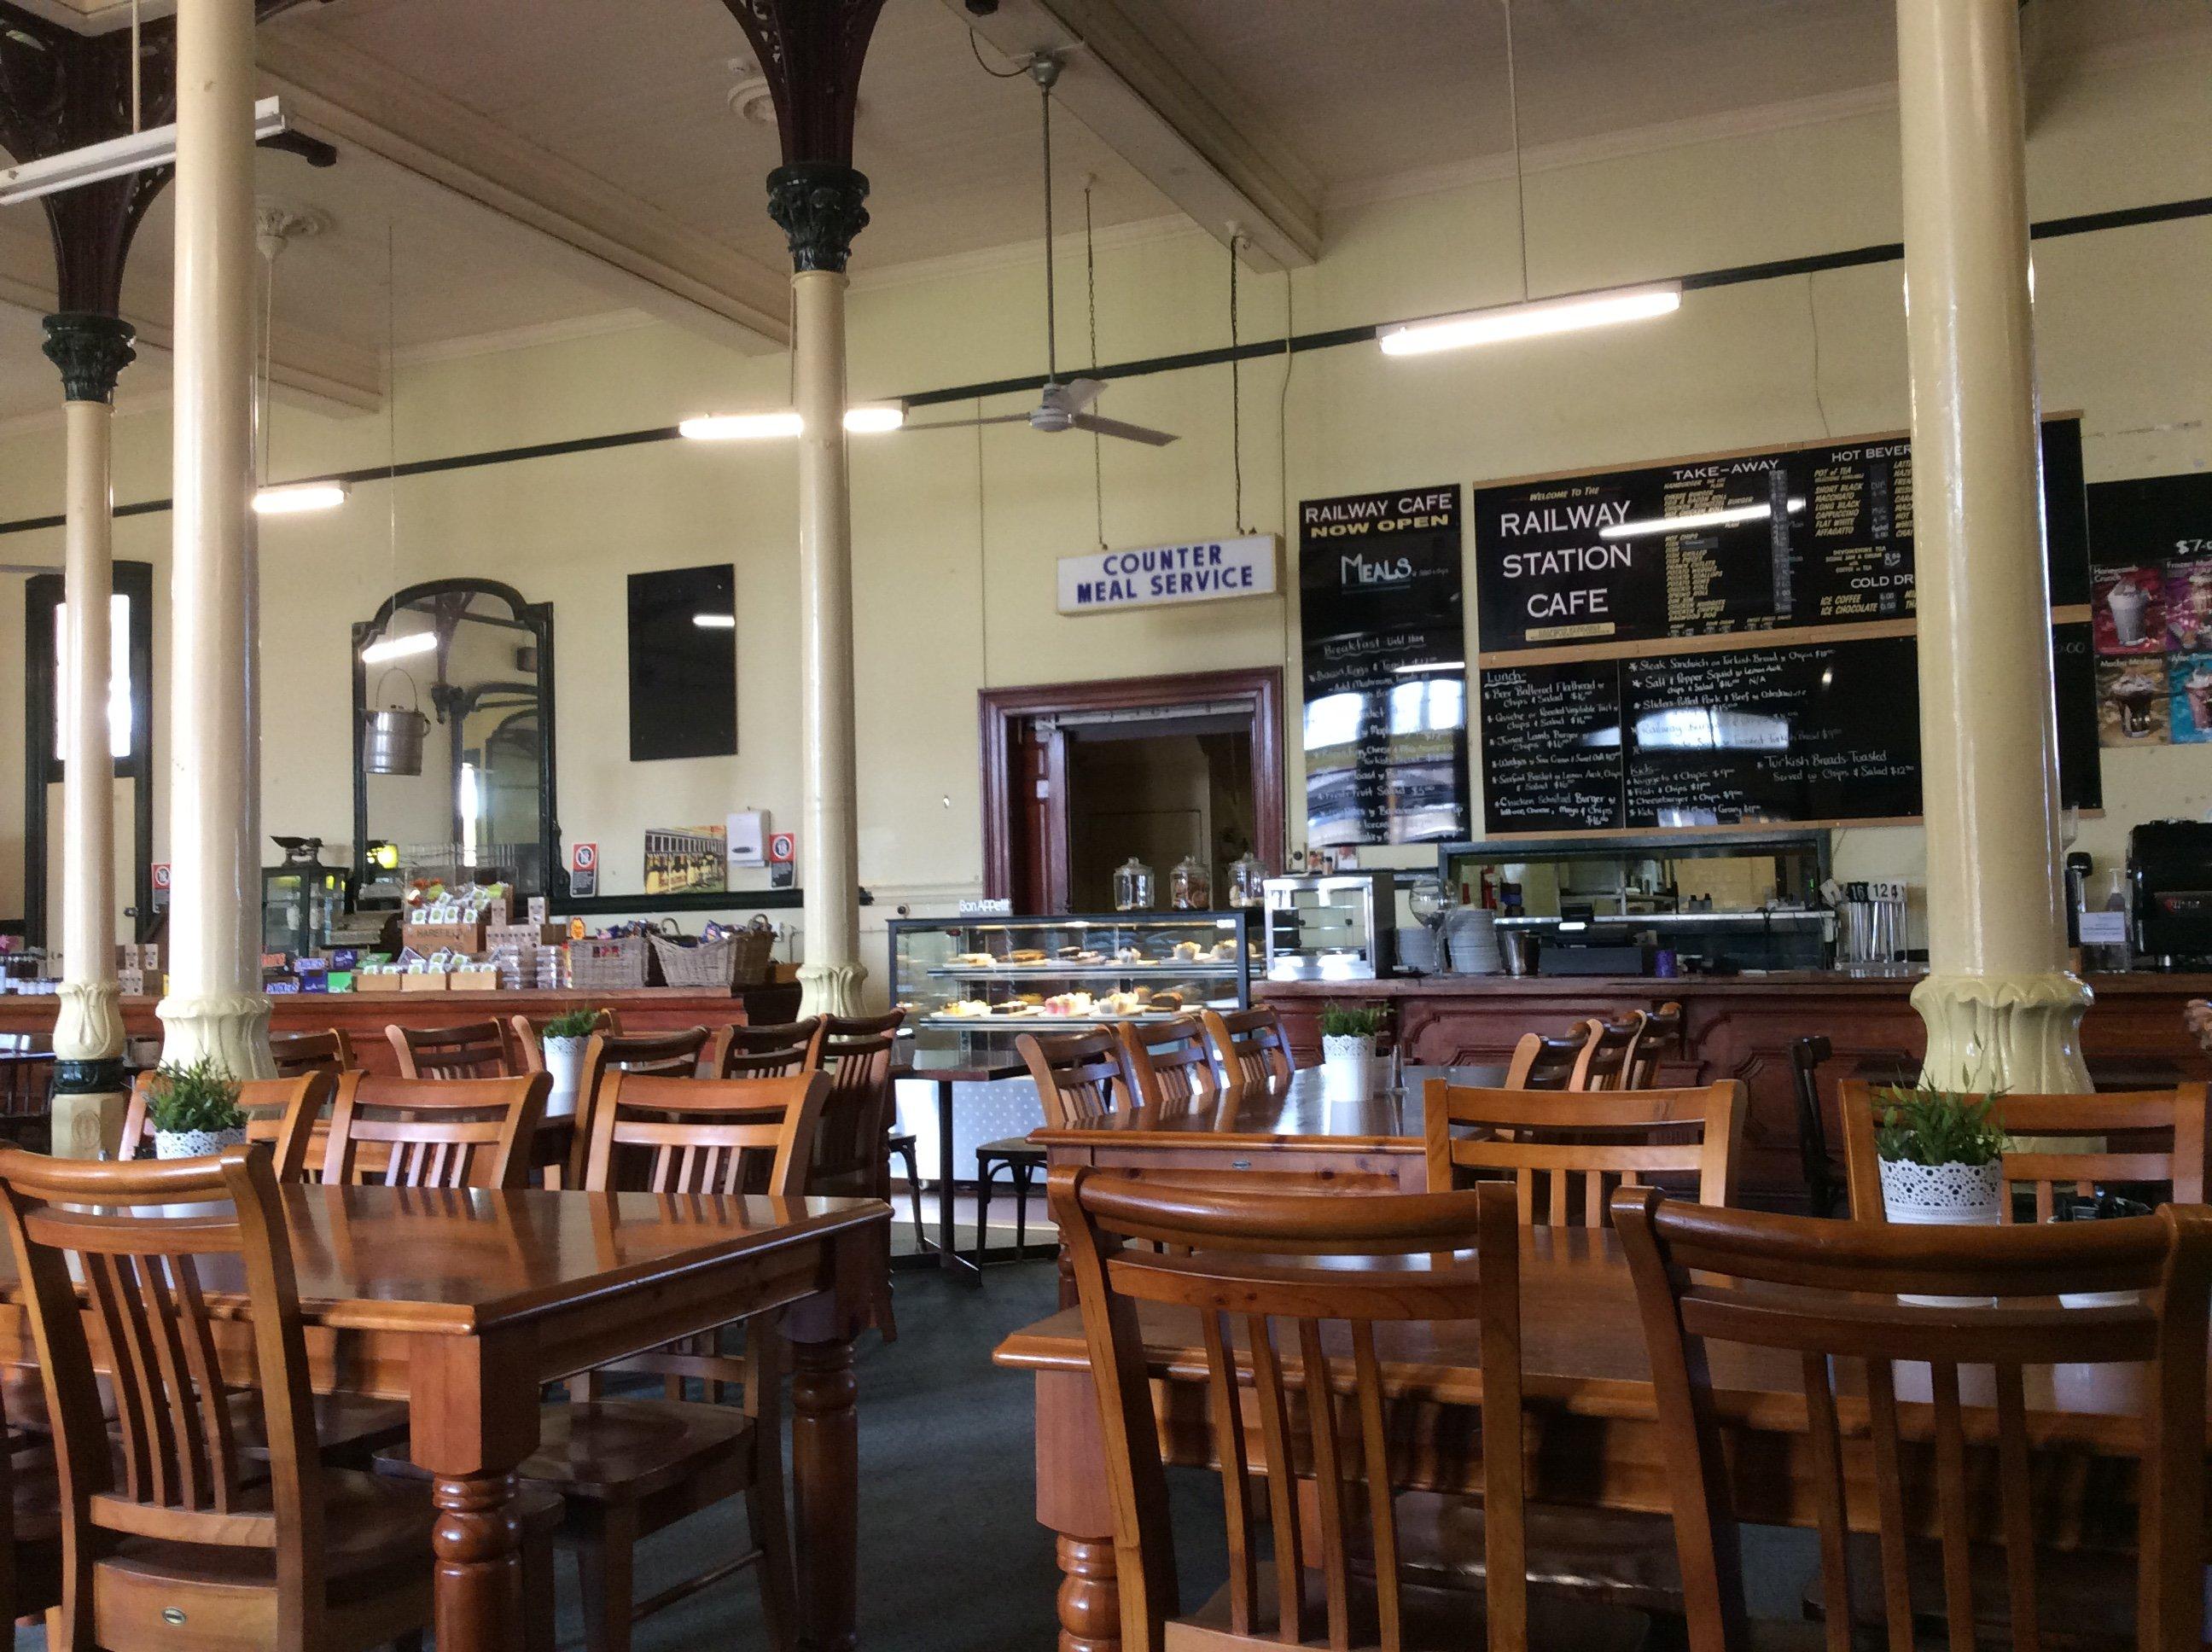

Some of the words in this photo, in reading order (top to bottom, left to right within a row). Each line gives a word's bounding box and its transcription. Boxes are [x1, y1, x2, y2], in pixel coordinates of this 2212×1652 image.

[1831, 450, 1861, 462] HOT
[1673, 459, 1779, 480] TAKE-AWAY
[1814, 468, 1828, 477] POT
[1529, 491, 1569, 501] WELCOME
[1571, 488, 1581, 497] TO
[1585, 486, 1599, 496] THE
[1815, 485, 1839, 494] SHORT
[1840, 482, 1864, 492] BLACK
[1306, 500, 1388, 524] RAILWAY
[1398, 493, 1452, 514] CAFE
[1815, 502, 1835, 511] LONG
[1837, 499, 1861, 509] BLACK
[1311, 522, 1370, 538] NOW
[1377, 514, 1449, 532] OPEN
[1500, 500, 1631, 538] RAILWAY
[1815, 520, 1832, 528] FLAT
[1833, 518, 1855, 527] WHITE
[1103, 544, 1221, 576] COUNTER
[1503, 543, 1632, 579] STATION
[1077, 579, 1138, 603] MEAL
[1150, 566, 1253, 596] SERVICE
[1851, 576, 1889, 589] COLD
[1527, 588, 1609, 618] CAFE
[1820, 596, 1833, 606] ICE
[1834, 594, 1862, 604] COFFEE
[1820, 606, 1833, 615] ICE
[1835, 603, 1878, 614] CHOCOLATE
[1324, 638, 1380, 655] Breakfast
[1639, 660, 1666, 671] Steak
[1670, 657, 1708, 669] Sandwich
[1722, 654, 1751, 666] Turkish
[1752, 652, 1778, 664] Bread
[1644, 676, 1666, 689] Salt
[1676, 672, 1702, 687] Pepper
[1707, 669, 1732, 683] Squid
[1749, 677, 1767, 685] N/A
[1503, 698, 1528, 708] Chips
[1537, 693, 1563, 704] Salad
[1732, 691, 1750, 703] Beef
[1495, 713, 1523, 723] Quiche
[1507, 721, 1530, 730] Chips
[1540, 717, 1565, 727] Salad
[1527, 730, 1550, 741] Lamb
[1552, 730, 1578, 742] Burger
[1512, 743, 1539, 753] Chips
[1764, 754, 1809, 768] Turkish
[1812, 753, 1846, 766] Breads
[1848, 750, 1888, 763] Toasted
[1633, 774, 1670, 786] Nuggets
[1679, 770, 1708, 782] Chips
[1773, 770, 1803, 782] Served
[1822, 768, 1849, 782] Chips
[1861, 765, 1888, 777] Salad
[1665, 784, 1687, 794] Chips
[1500, 796, 1534, 807] Chicken
[1575, 792, 1604, 806] Burger
[1699, 793, 1721, 803] Chips
[1587, 806, 1613, 817] Chips
[1872, 882, 1888, 898] 12
[959, 899, 977, 912] Bon
